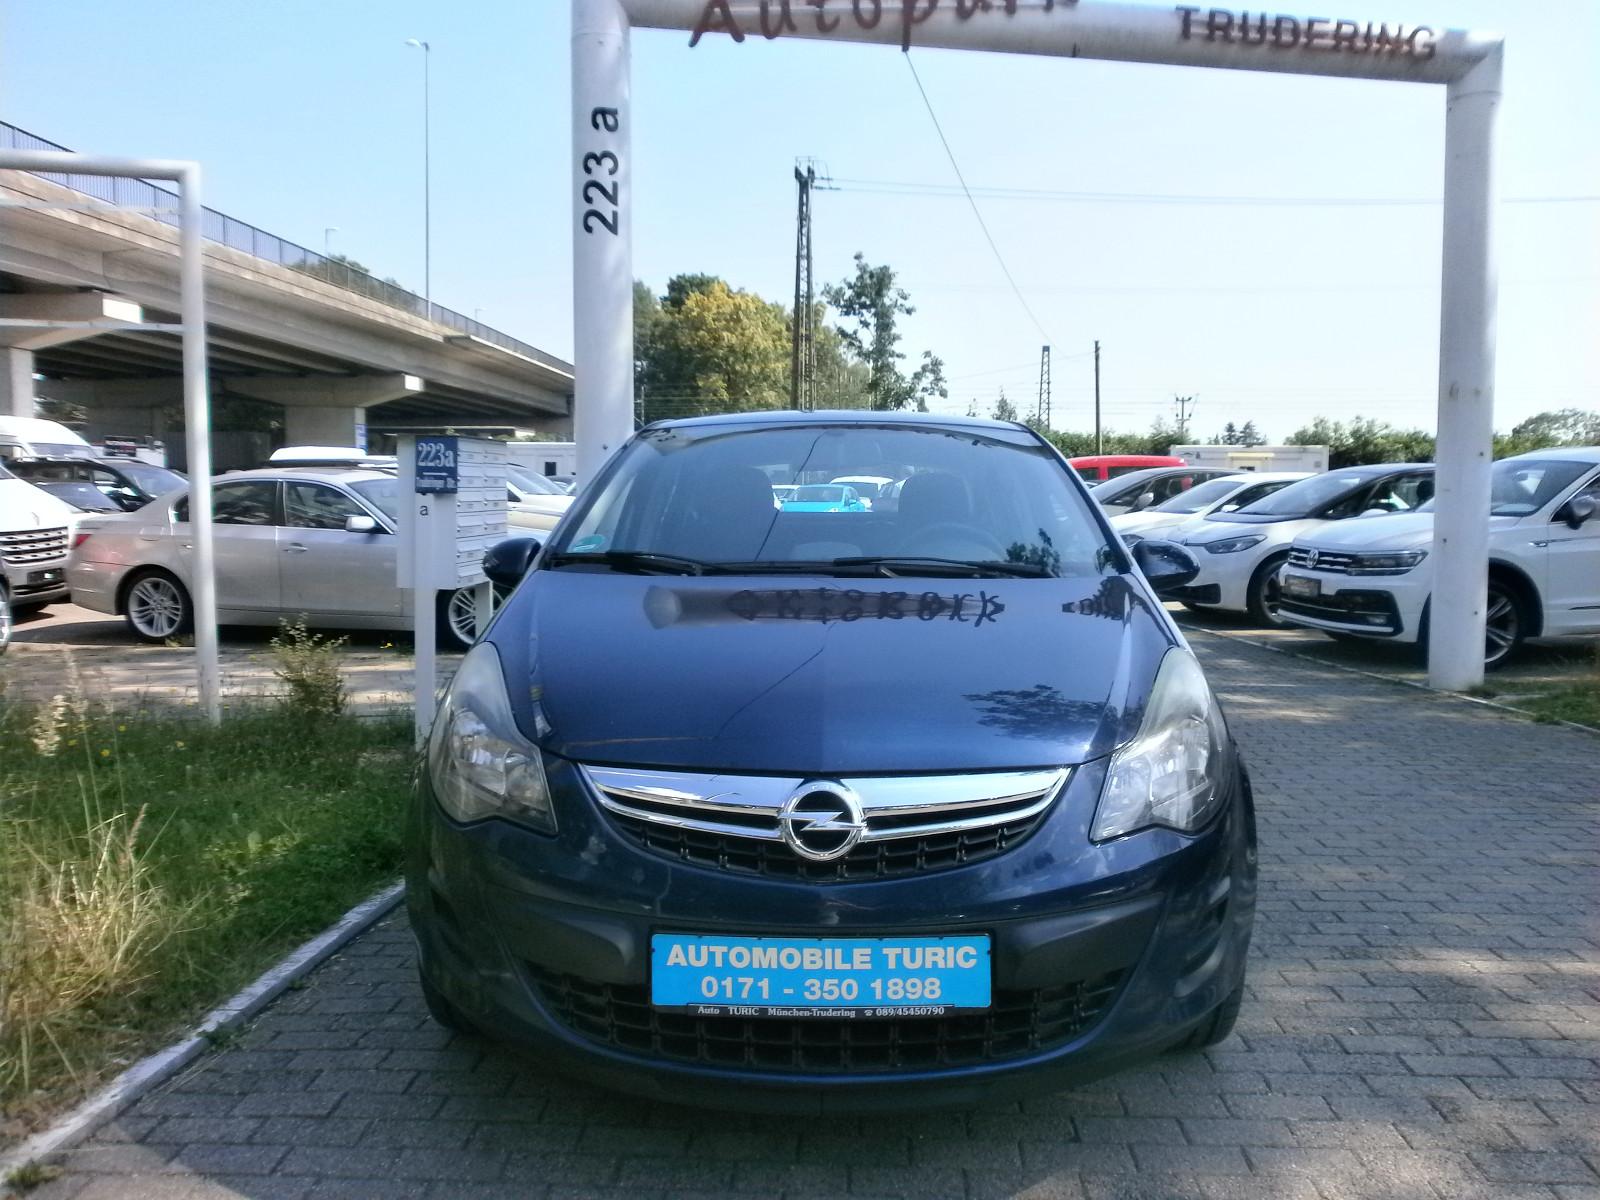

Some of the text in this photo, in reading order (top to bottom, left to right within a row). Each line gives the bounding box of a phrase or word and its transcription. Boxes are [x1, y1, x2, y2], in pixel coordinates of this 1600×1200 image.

[1175, 4, 1437, 61] TRUDERING
[582, 106, 619, 236] 223 a
[417, 442, 455, 468] 223a
[420, 505, 429, 516] a
[666, 944, 978, 970] AUTOMOBILE TURIC
[701, 975, 770, 1000] 0171
[803, 977, 859, 1001] 350
[870, 977, 942, 1000] 1898
[697, 1005, 945, 1018] Auto TURIC München-Trudering 089/45450790
